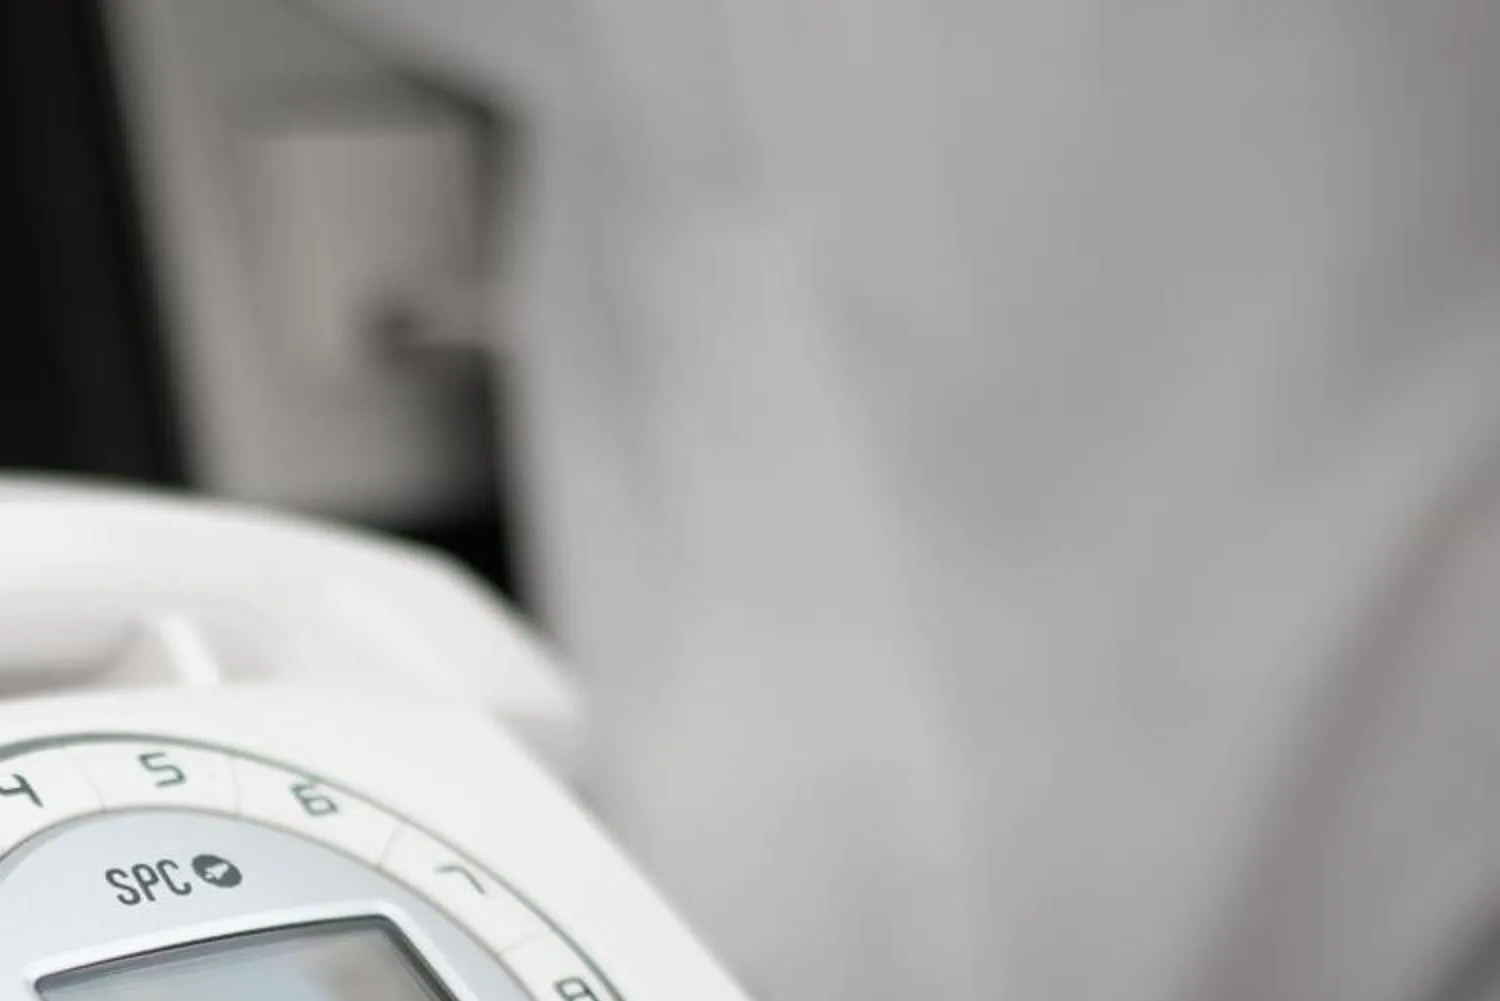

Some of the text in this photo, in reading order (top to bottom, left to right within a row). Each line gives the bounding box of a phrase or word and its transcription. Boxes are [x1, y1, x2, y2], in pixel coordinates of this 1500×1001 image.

[137, 752, 186, 789] 5
[290, 781, 340, 818] 6
[104, 857, 193, 906] SPC
[433, 864, 486, 896] 7
